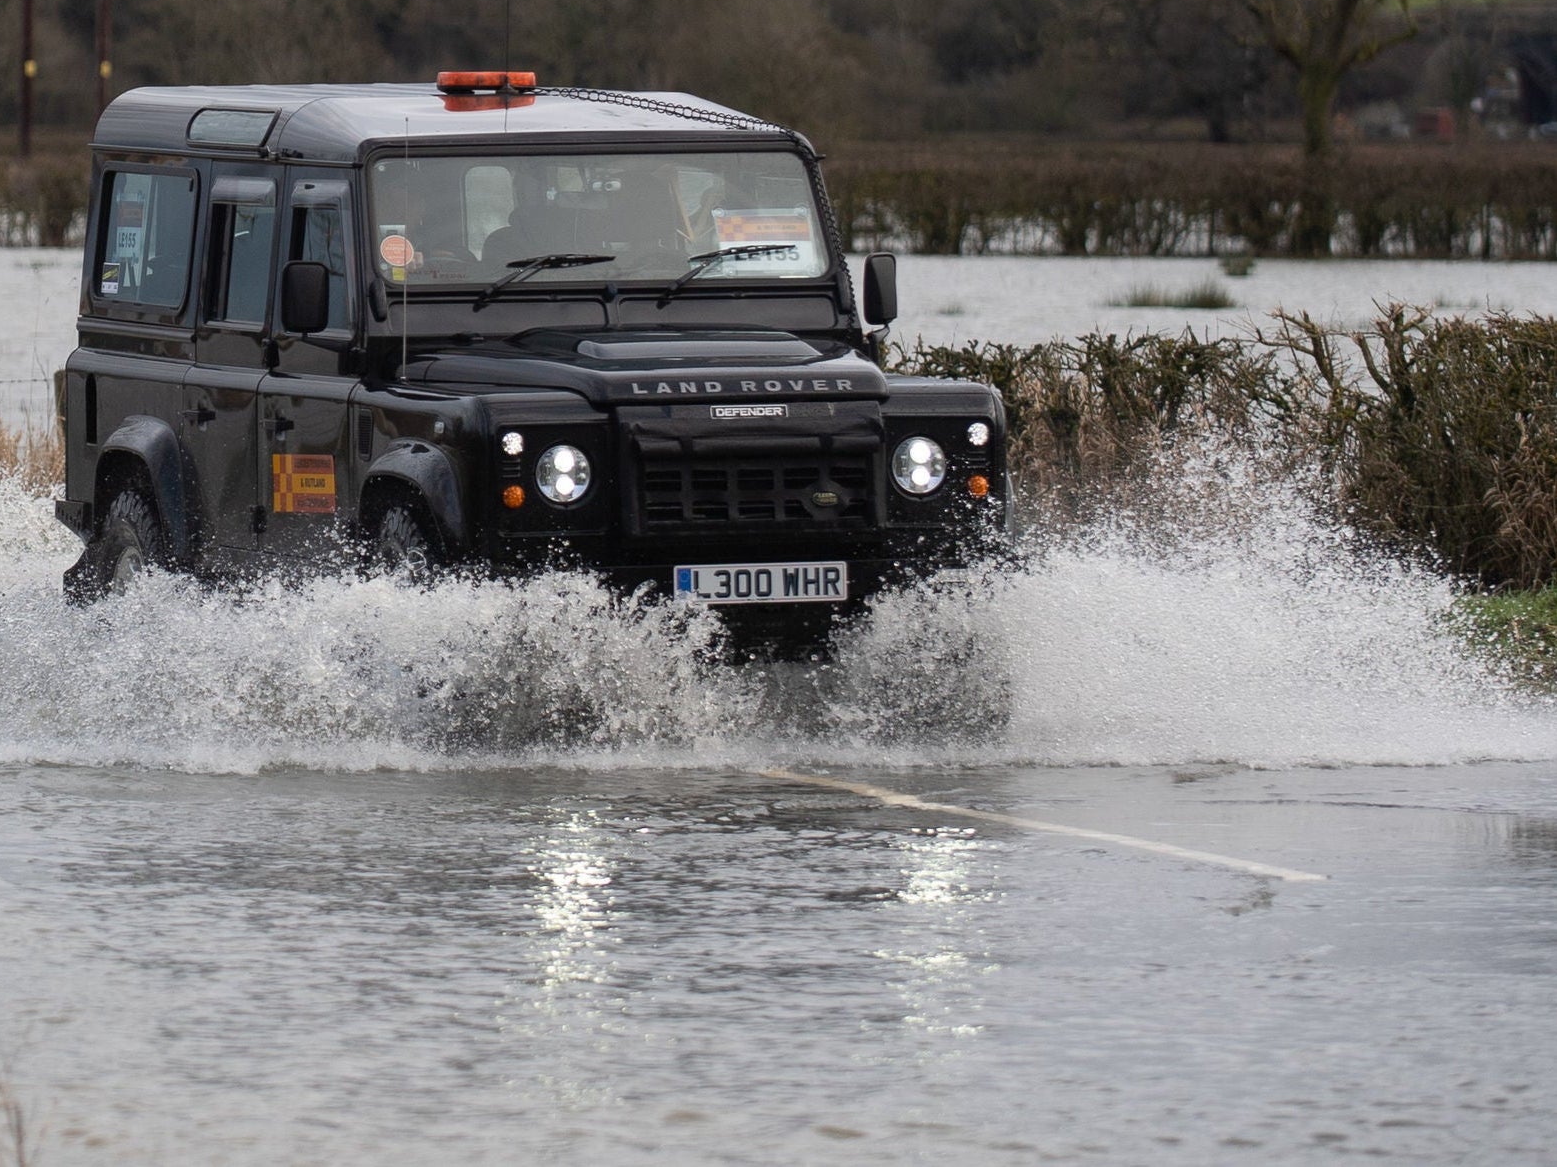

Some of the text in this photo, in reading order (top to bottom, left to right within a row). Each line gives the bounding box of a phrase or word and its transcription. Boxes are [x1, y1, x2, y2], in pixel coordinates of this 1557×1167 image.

[631, 379, 853, 395] LAND ROVER
[715, 407, 783, 417] DEFENDER
[693, 566, 841, 599] L300 WHR
